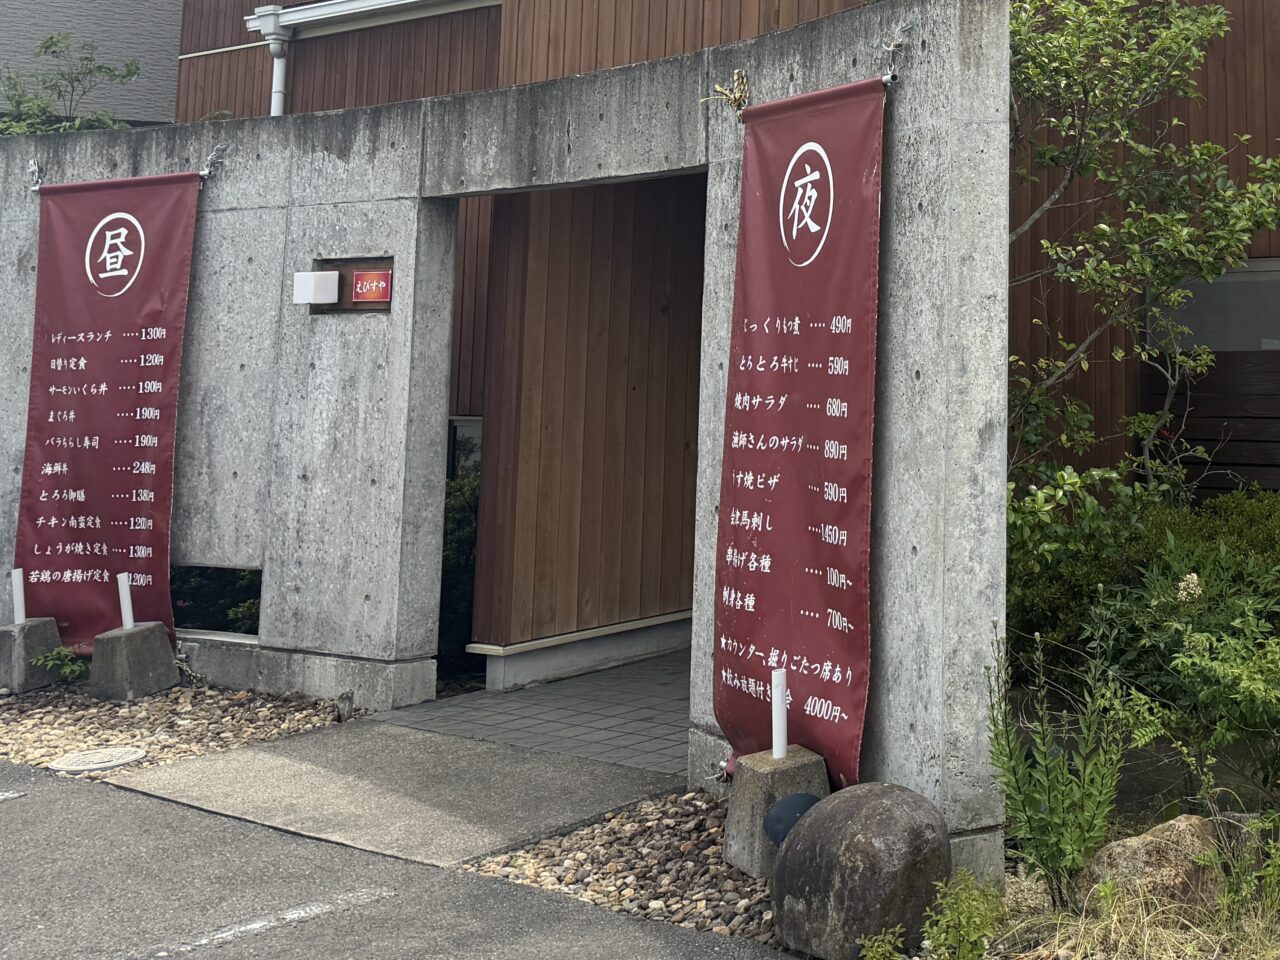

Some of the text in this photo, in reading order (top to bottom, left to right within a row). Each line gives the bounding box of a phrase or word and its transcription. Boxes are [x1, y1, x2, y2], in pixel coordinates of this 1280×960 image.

[787, 163, 821, 240] 夜
[97, 227, 135, 279] 昼
[355, 279, 387, 294] えびすや
[743, 315, 852, 335] じっくりもつ煮 490円
[51, 330, 112, 344] レディースランチ
[50, 356, 88, 371] 日替り定食
[739, 354, 849, 376] とろとろ牛すじ 590円
[48, 382, 109, 396] サーモンいくら丼
[734, 391, 848, 418] 焼肉サラダ 680円
[48, 409, 76, 423] まぐろ丼
[45, 435, 100, 450] バラちらし寿司
[731, 430, 848, 461] 漁師さんのサラダ 890円
[40, 462, 69, 476] 海鮮丼
[732, 469, 848, 503] す焼ピザ 590円
[39, 488, 86, 502] とろろ御膳
[35, 515, 102, 529] チキン南蛮定食
[820, 522, 848, 547] 1450円
[33, 542, 108, 556] しょうが焼き定食
[725, 546, 772, 573] 串揚げ各種
[28, 569, 111, 583] 若鶏の唐揚げ定食
[722, 585, 756, 612] 刺身各種
